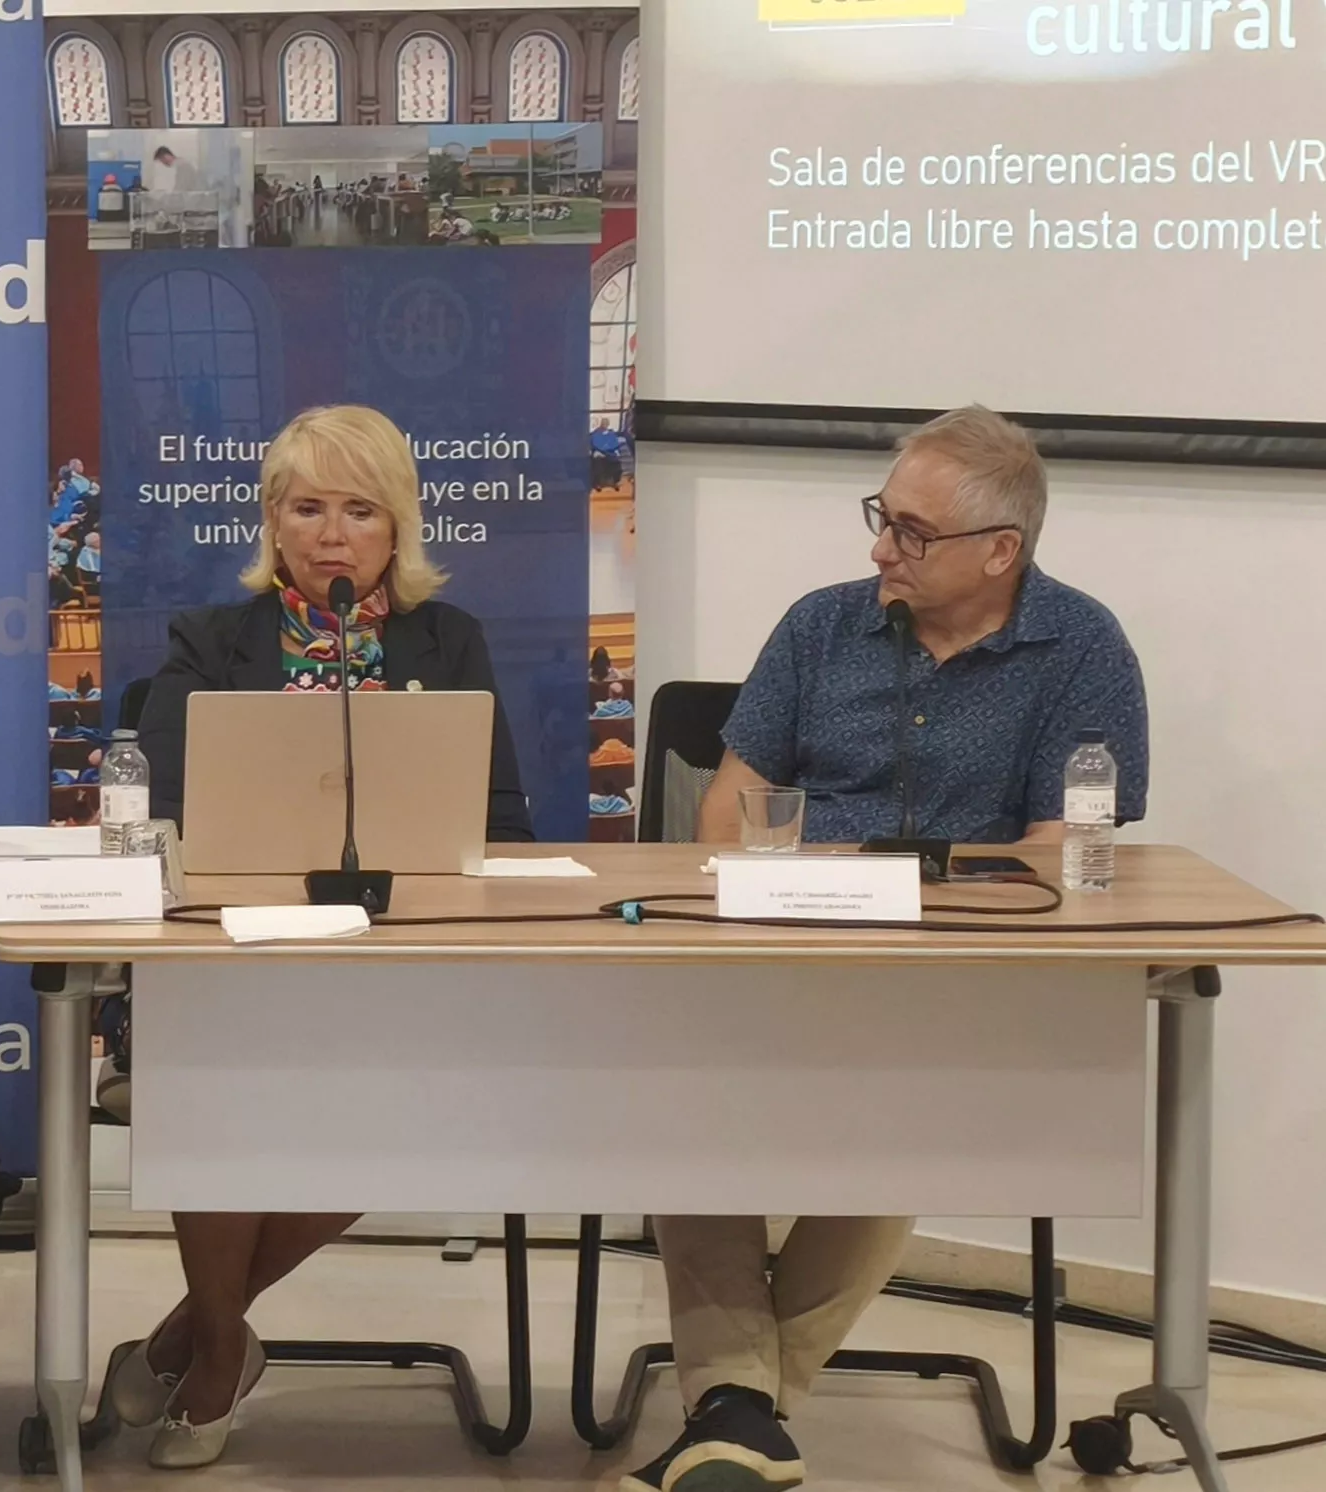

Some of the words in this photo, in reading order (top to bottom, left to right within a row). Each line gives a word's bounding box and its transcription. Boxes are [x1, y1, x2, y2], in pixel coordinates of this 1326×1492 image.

[1026, 0, 1297, 56] cultural
[768, 146, 848, 186] Sala
[862, 146, 906, 186] de
[919, 142, 1176, 186] conferencias
[1191, 140, 1254, 183] del
[1269, 139, 1326, 182] VR
[767, 208, 911, 249] Entrada
[927, 208, 1014, 249] libre
[1028, 208, 1137, 249] hasta
[1153, 207, 1326, 261] complet
[159, 434, 185, 462] El
[192, 434, 272, 462] futur
[405, 432, 530, 460] ucación
[138, 475, 264, 508] superior
[472, 481, 510, 501] en
[518, 473, 544, 501] la
